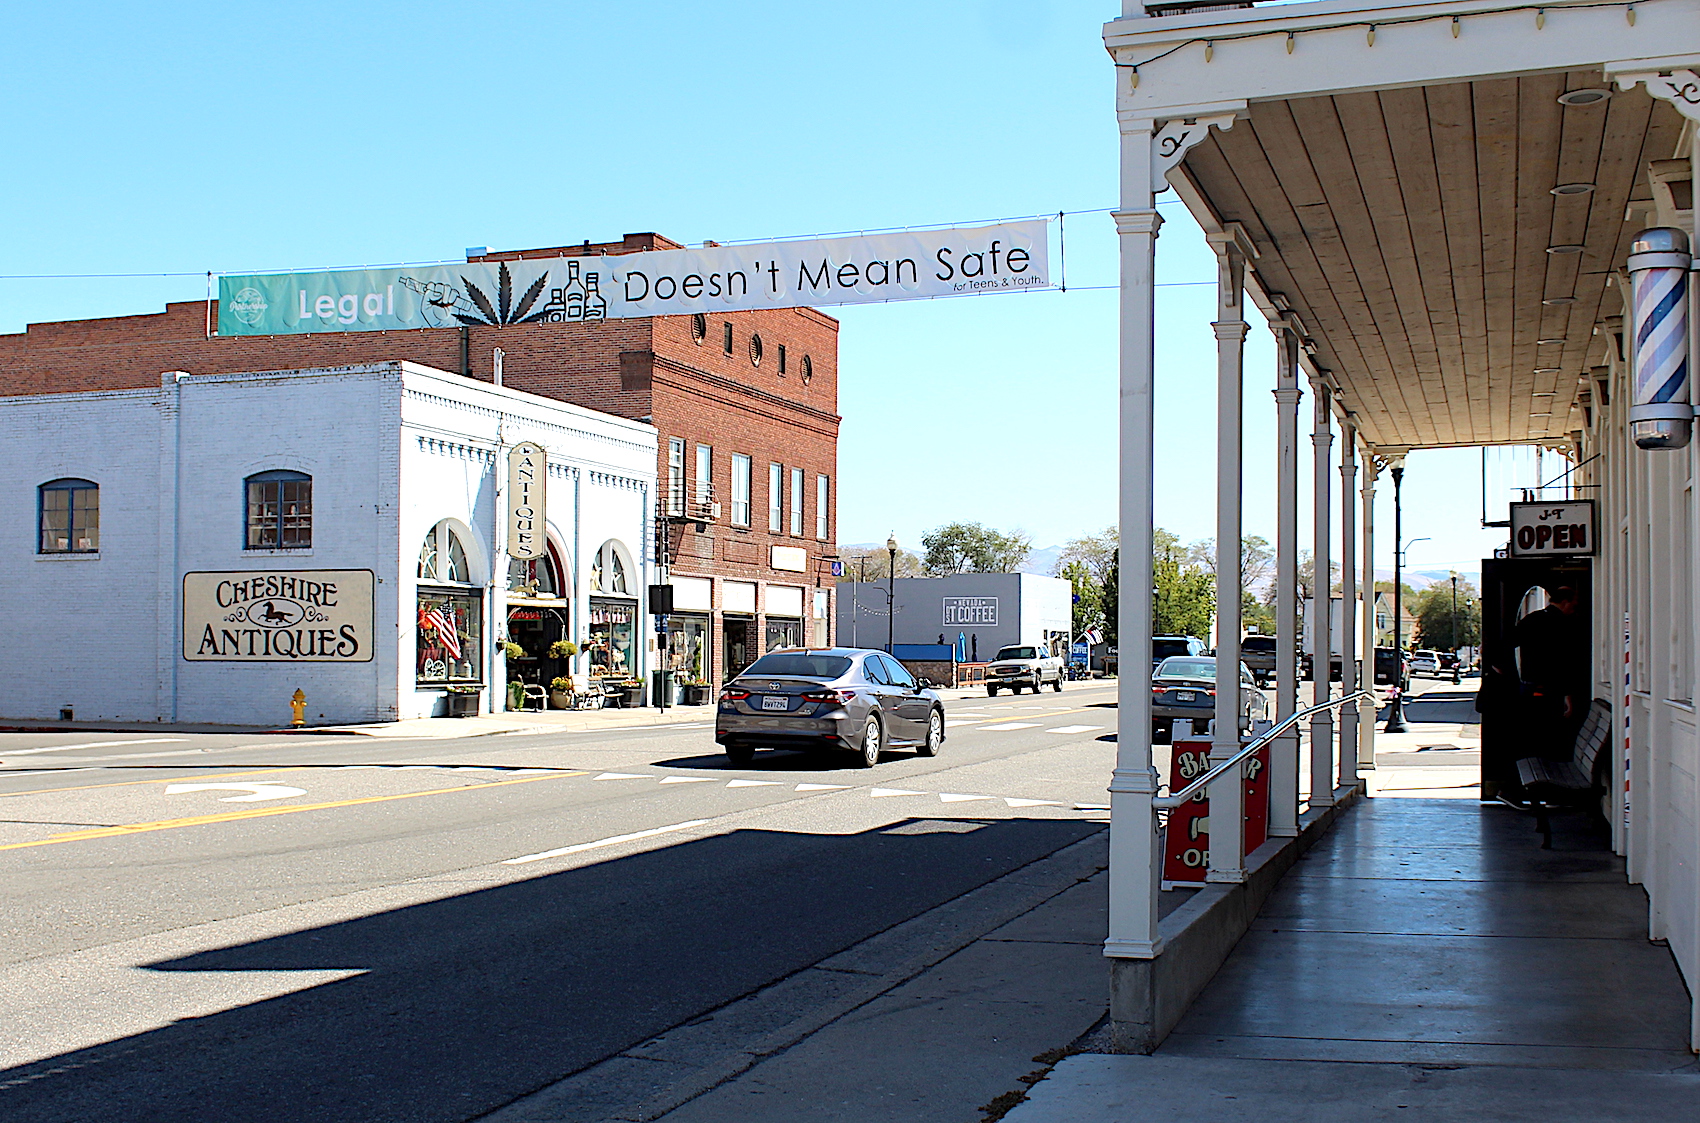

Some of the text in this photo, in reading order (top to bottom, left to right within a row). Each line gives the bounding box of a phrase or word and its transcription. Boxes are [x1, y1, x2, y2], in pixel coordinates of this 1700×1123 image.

[300, 240, 1030, 325] Legal Doesn't Mean Safe
[953, 275, 1044, 291] for Teens & Youth.
[515, 457, 534, 556] ANTIQUES
[1517, 524, 1587, 550] OPEN
[216, 575, 338, 608] CHESHIRE
[958, 605, 995, 622] COFFEE
[197, 623, 359, 659] ANTIQUES
[1178, 752, 1262, 780] BAR
[1183, 848, 1210, 867] OP
